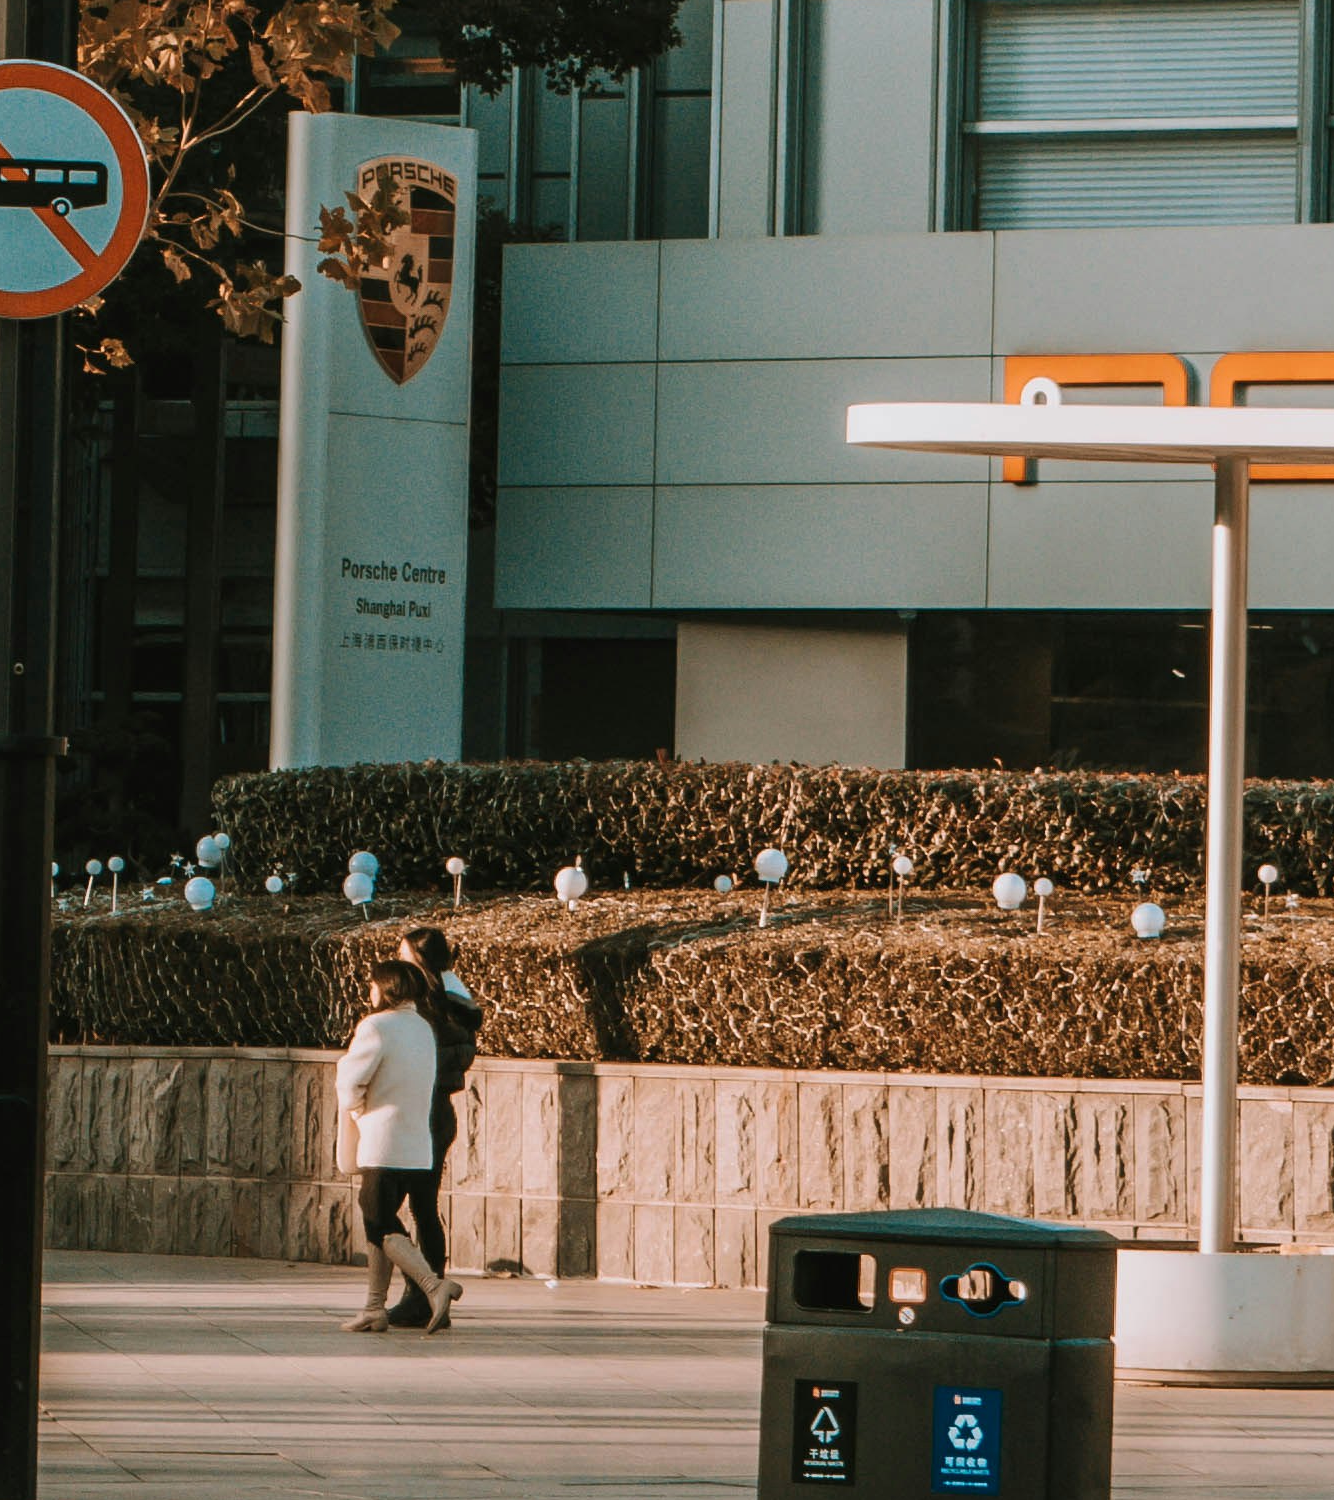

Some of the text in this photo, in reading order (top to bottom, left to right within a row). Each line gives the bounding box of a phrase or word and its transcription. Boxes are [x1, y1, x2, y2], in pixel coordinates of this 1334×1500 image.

[362, 161, 456, 198] PORSCHE
[341, 557, 446, 585] Porsche Centre
[356, 598, 431, 619] Shanghai Puxi
